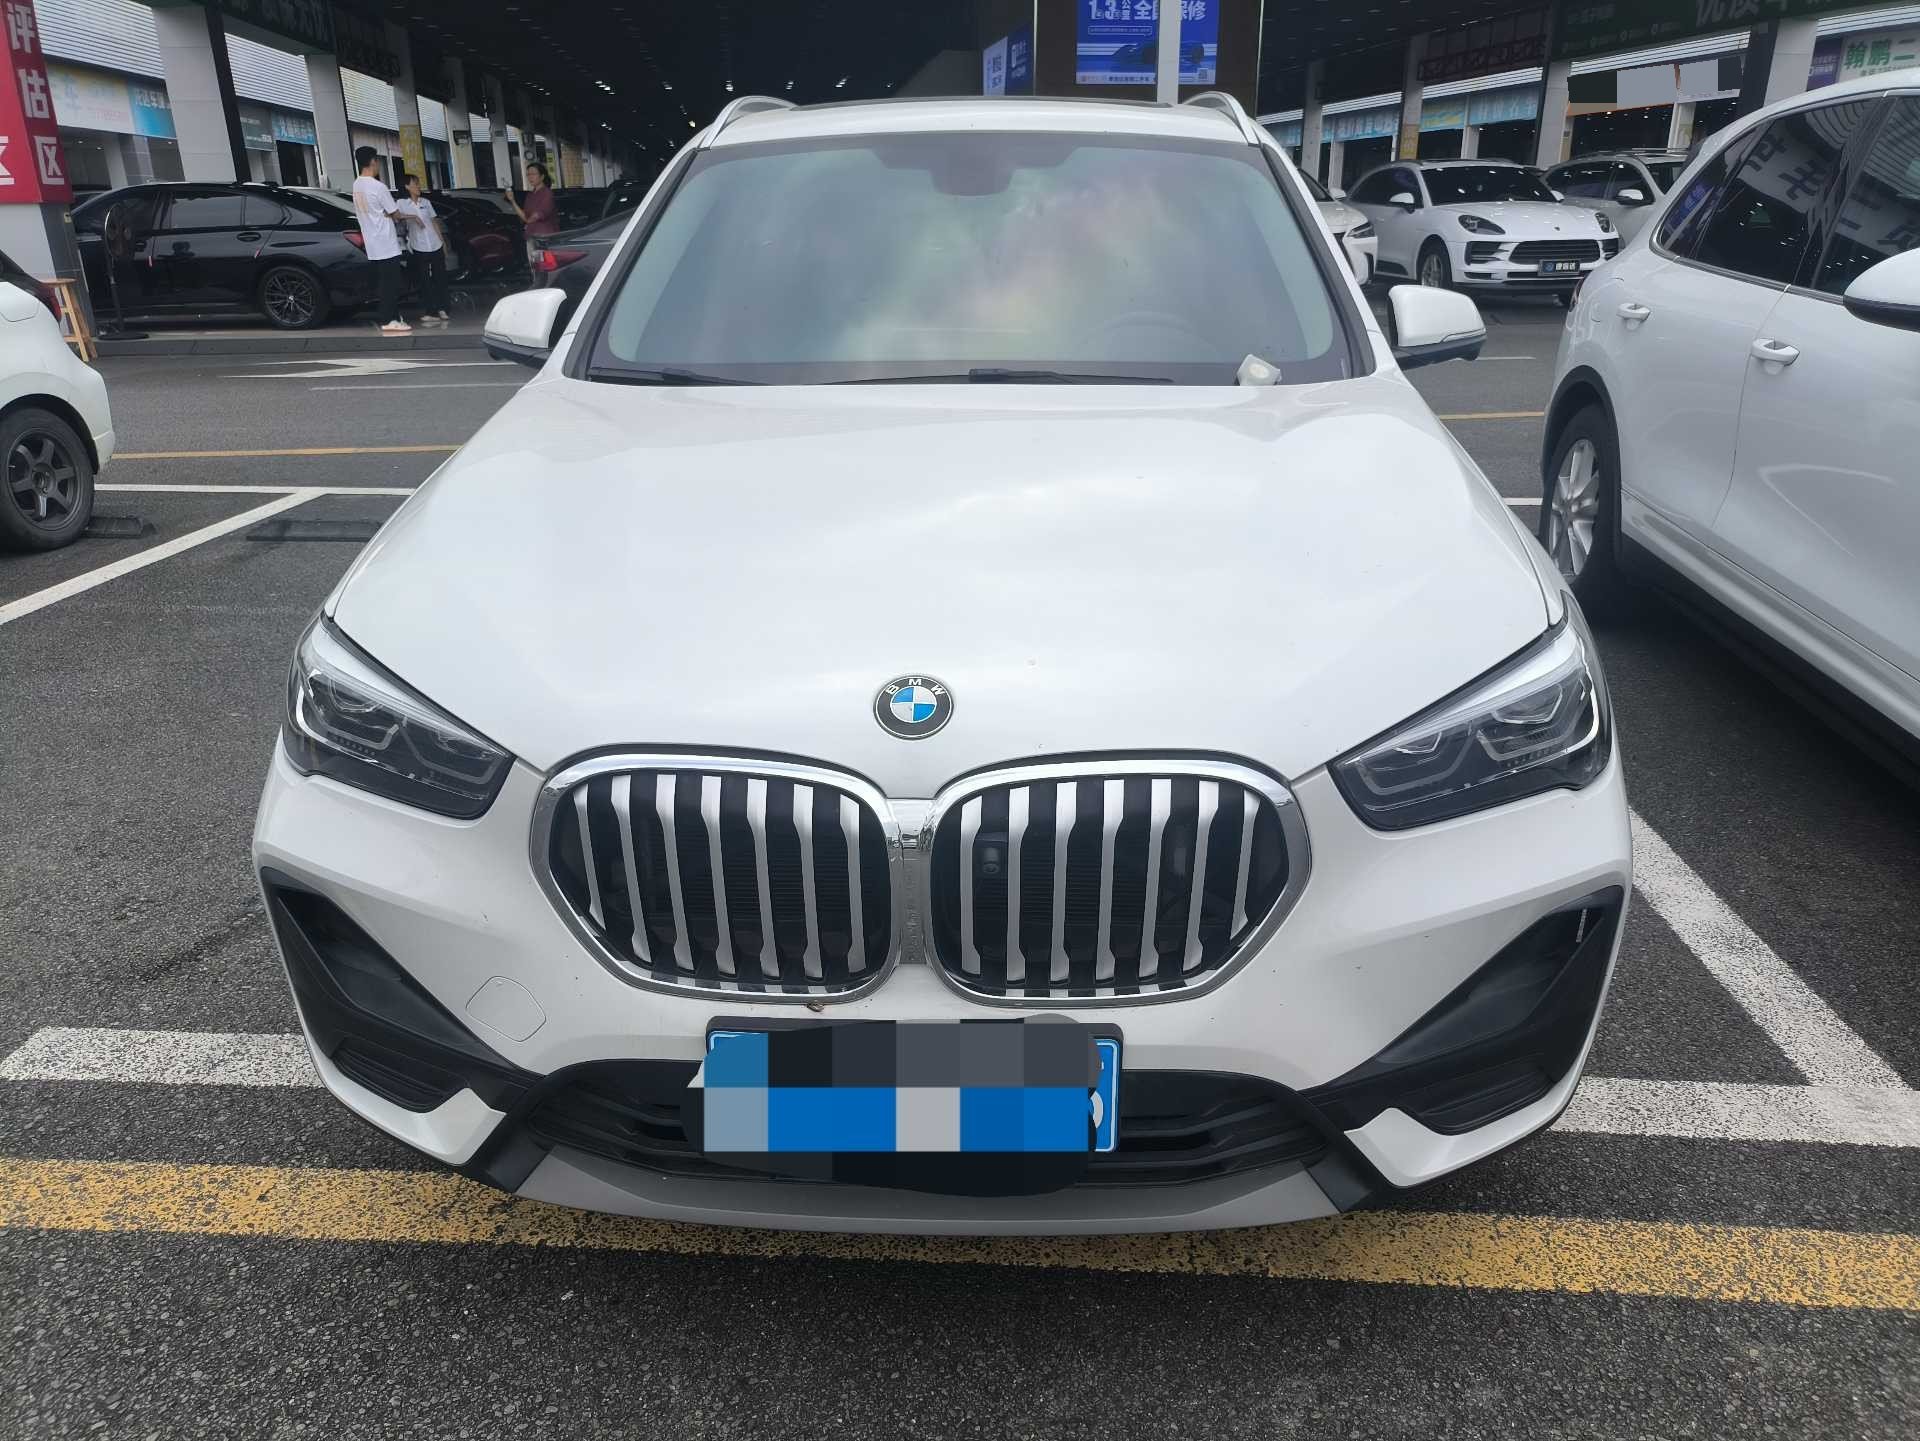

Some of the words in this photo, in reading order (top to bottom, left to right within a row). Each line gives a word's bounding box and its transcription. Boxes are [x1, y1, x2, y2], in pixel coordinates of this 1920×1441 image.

[8, 3, 65, 185] 评估区
[886, 679, 946, 695] BMW
